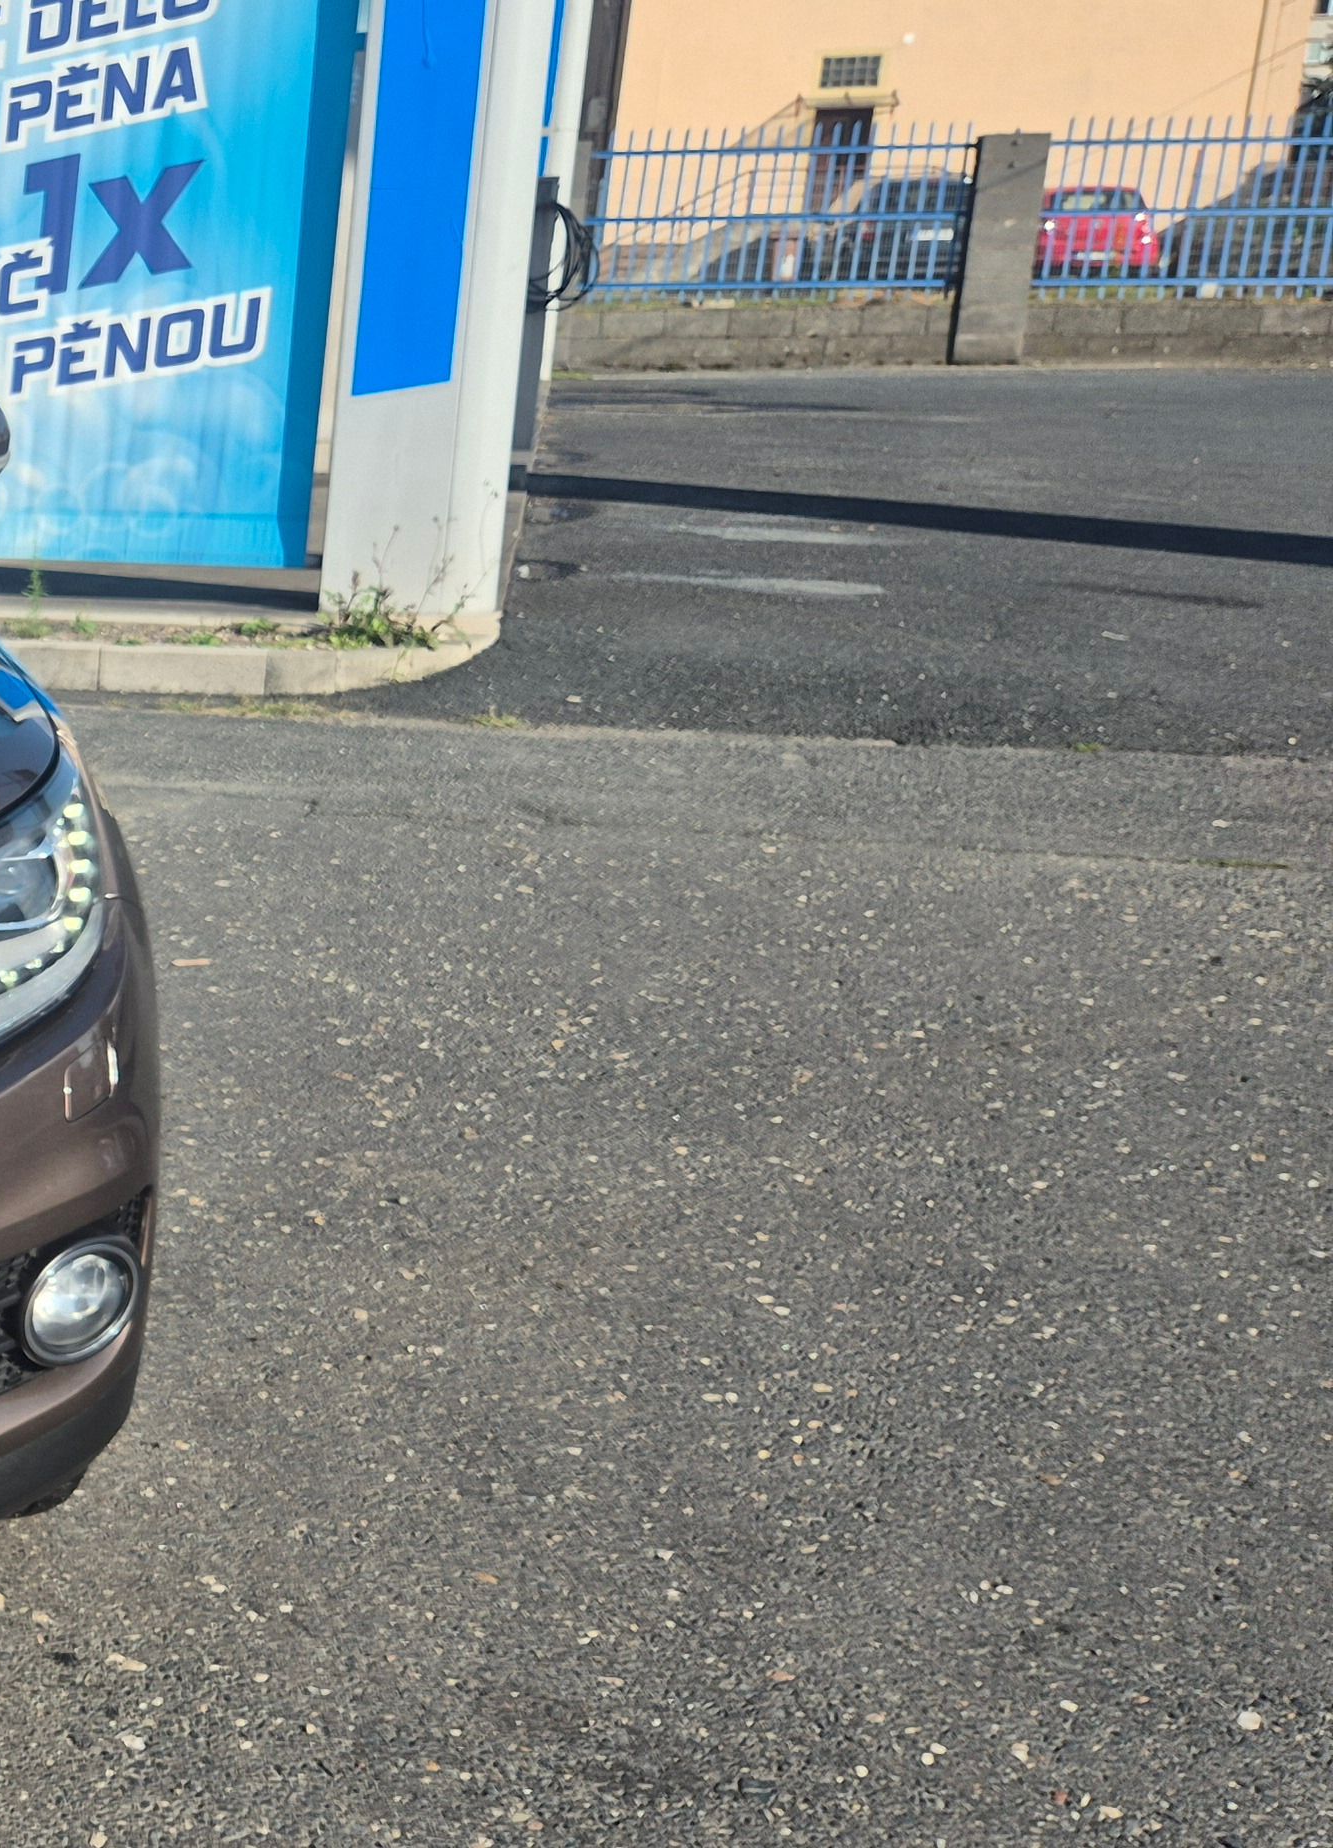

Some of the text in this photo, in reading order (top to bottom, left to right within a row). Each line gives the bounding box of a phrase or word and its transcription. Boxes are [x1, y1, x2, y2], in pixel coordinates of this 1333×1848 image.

[6, 46, 199, 143] PĚNA
[23, 153, 206, 295] 1x
[11, 297, 262, 395] PĚNOU
